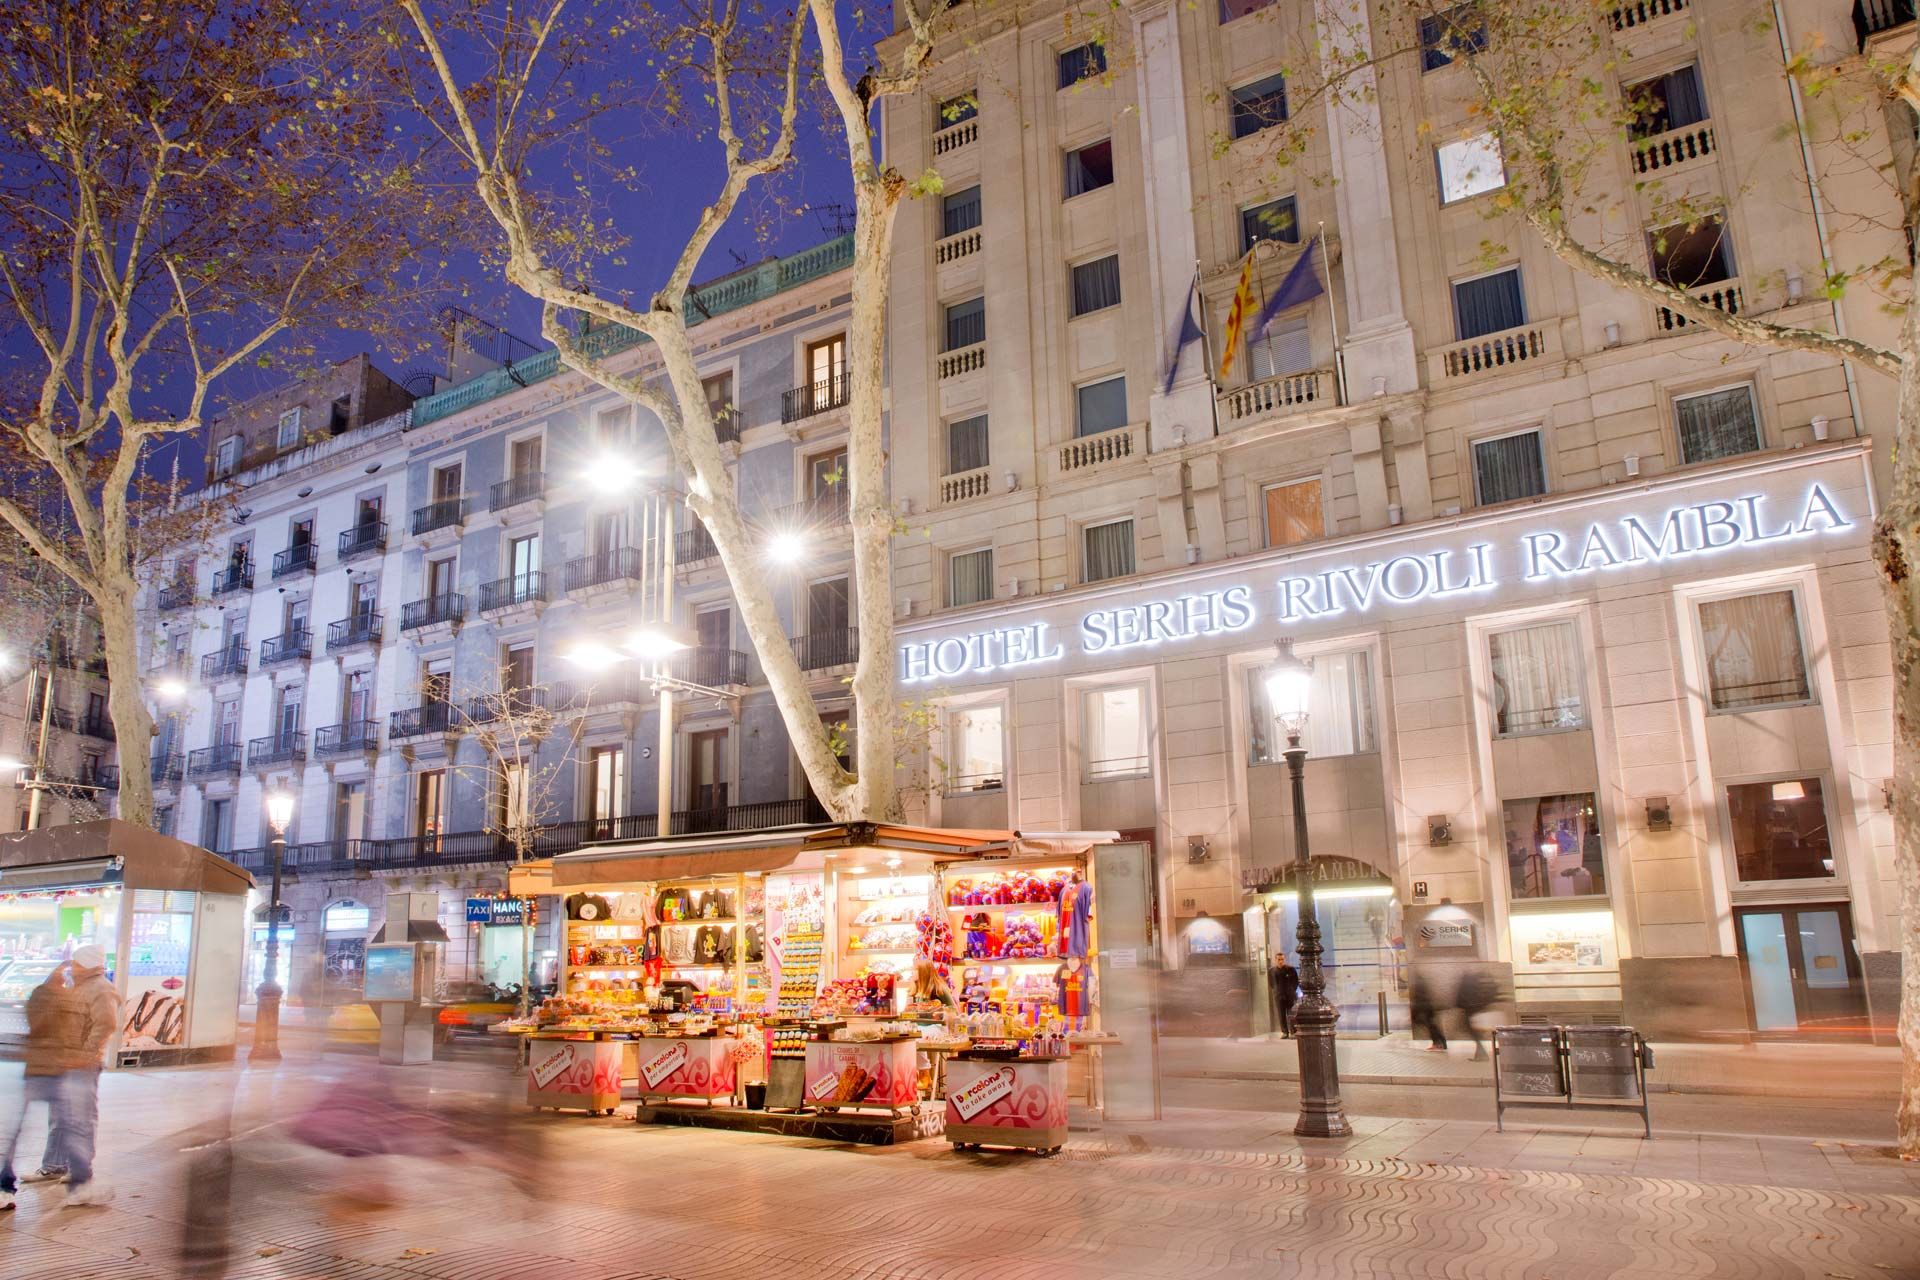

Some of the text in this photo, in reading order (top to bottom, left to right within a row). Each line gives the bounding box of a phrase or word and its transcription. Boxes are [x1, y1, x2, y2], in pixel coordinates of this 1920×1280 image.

[900, 483, 1852, 682] HOTEL SERHS RIVOLI RAMBLA
[1309, 860, 1381, 881] AMBLA
[1415, 883, 1426, 893] H
[467, 906, 490, 915] TAXI
[493, 901, 531, 913] HANGE
[1439, 925, 1469, 934] SERHS
[645, 1047, 677, 1074] Barcelona
[956, 1072, 1001, 1104] Barcelona
[962, 1080, 1006, 1112] to take away
